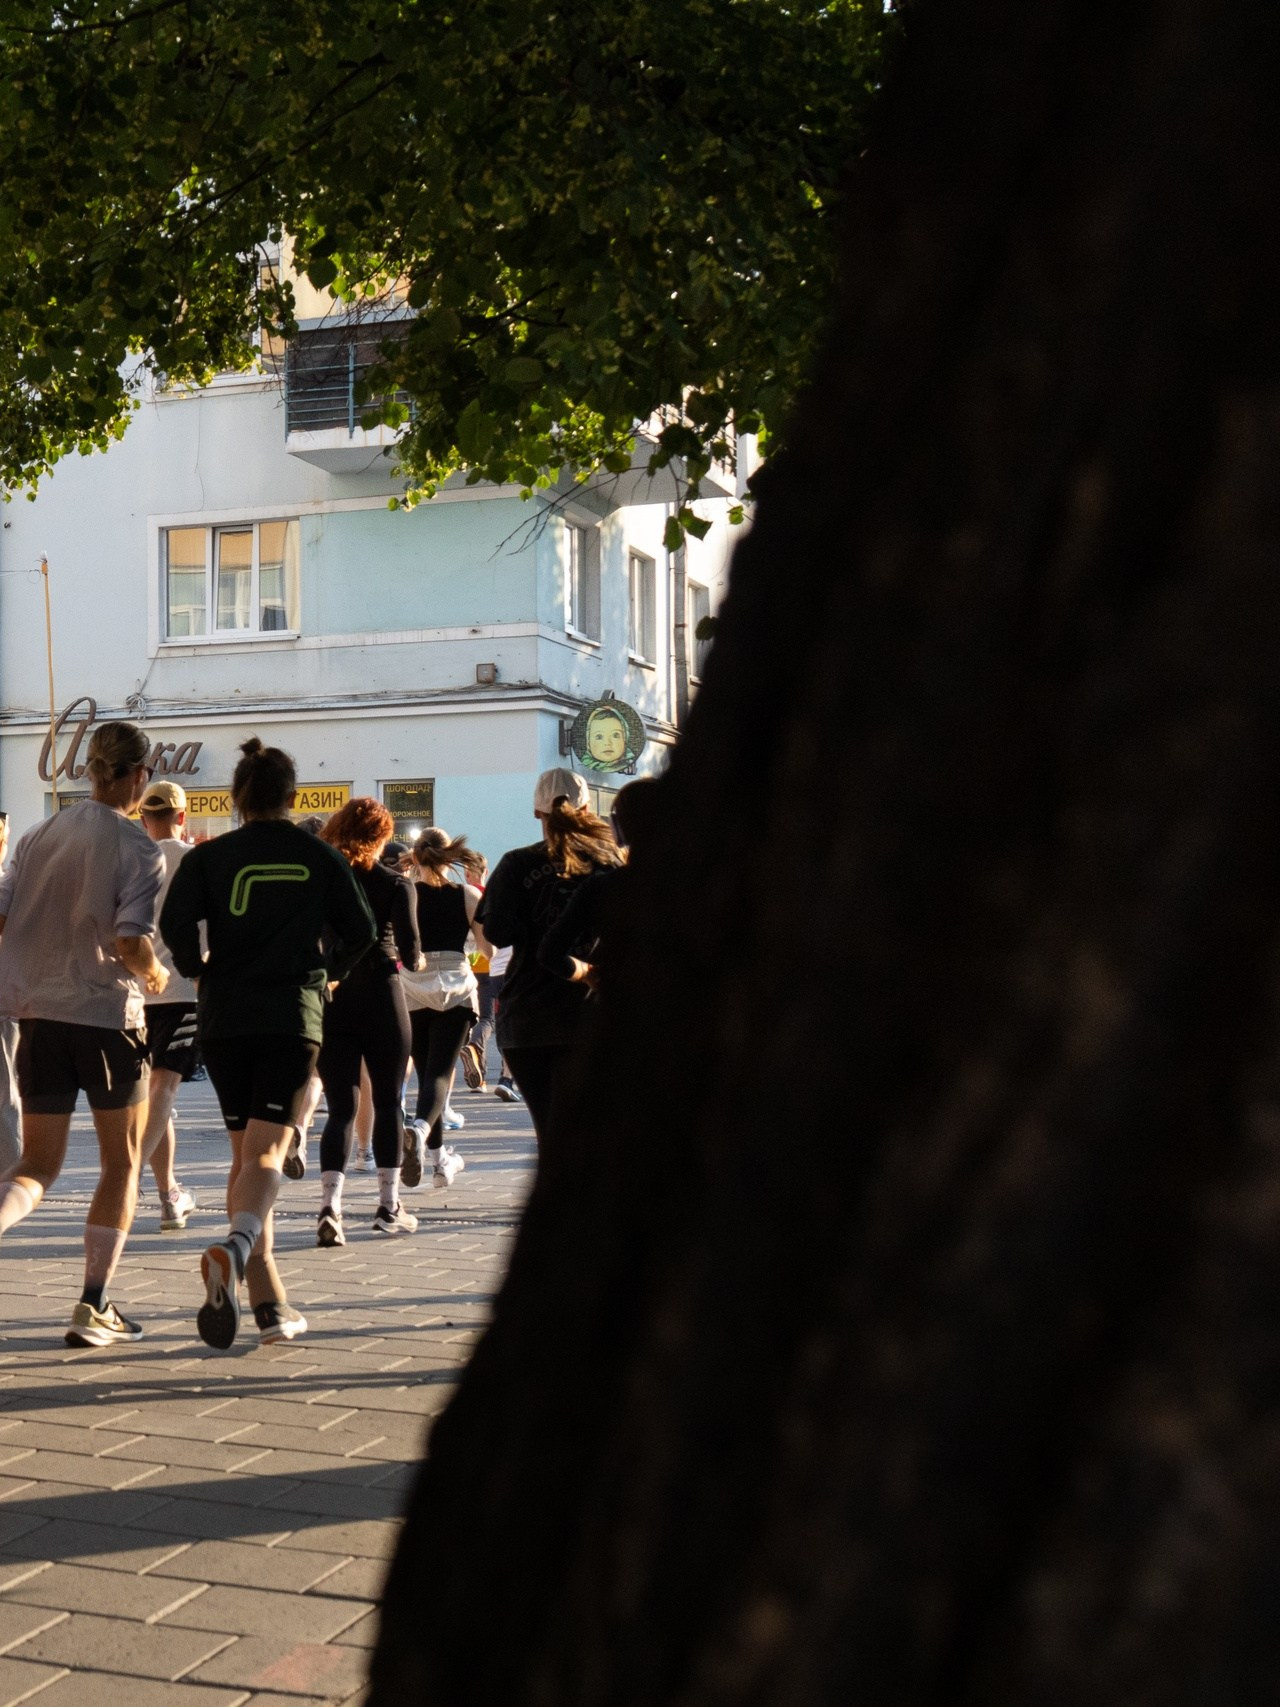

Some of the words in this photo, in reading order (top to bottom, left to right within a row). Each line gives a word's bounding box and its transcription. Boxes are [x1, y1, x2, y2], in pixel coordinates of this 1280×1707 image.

[38, 697, 204, 781] Ака
[186, 795, 230, 813] ЕРСК
[296, 791, 343, 809] АЗИН
